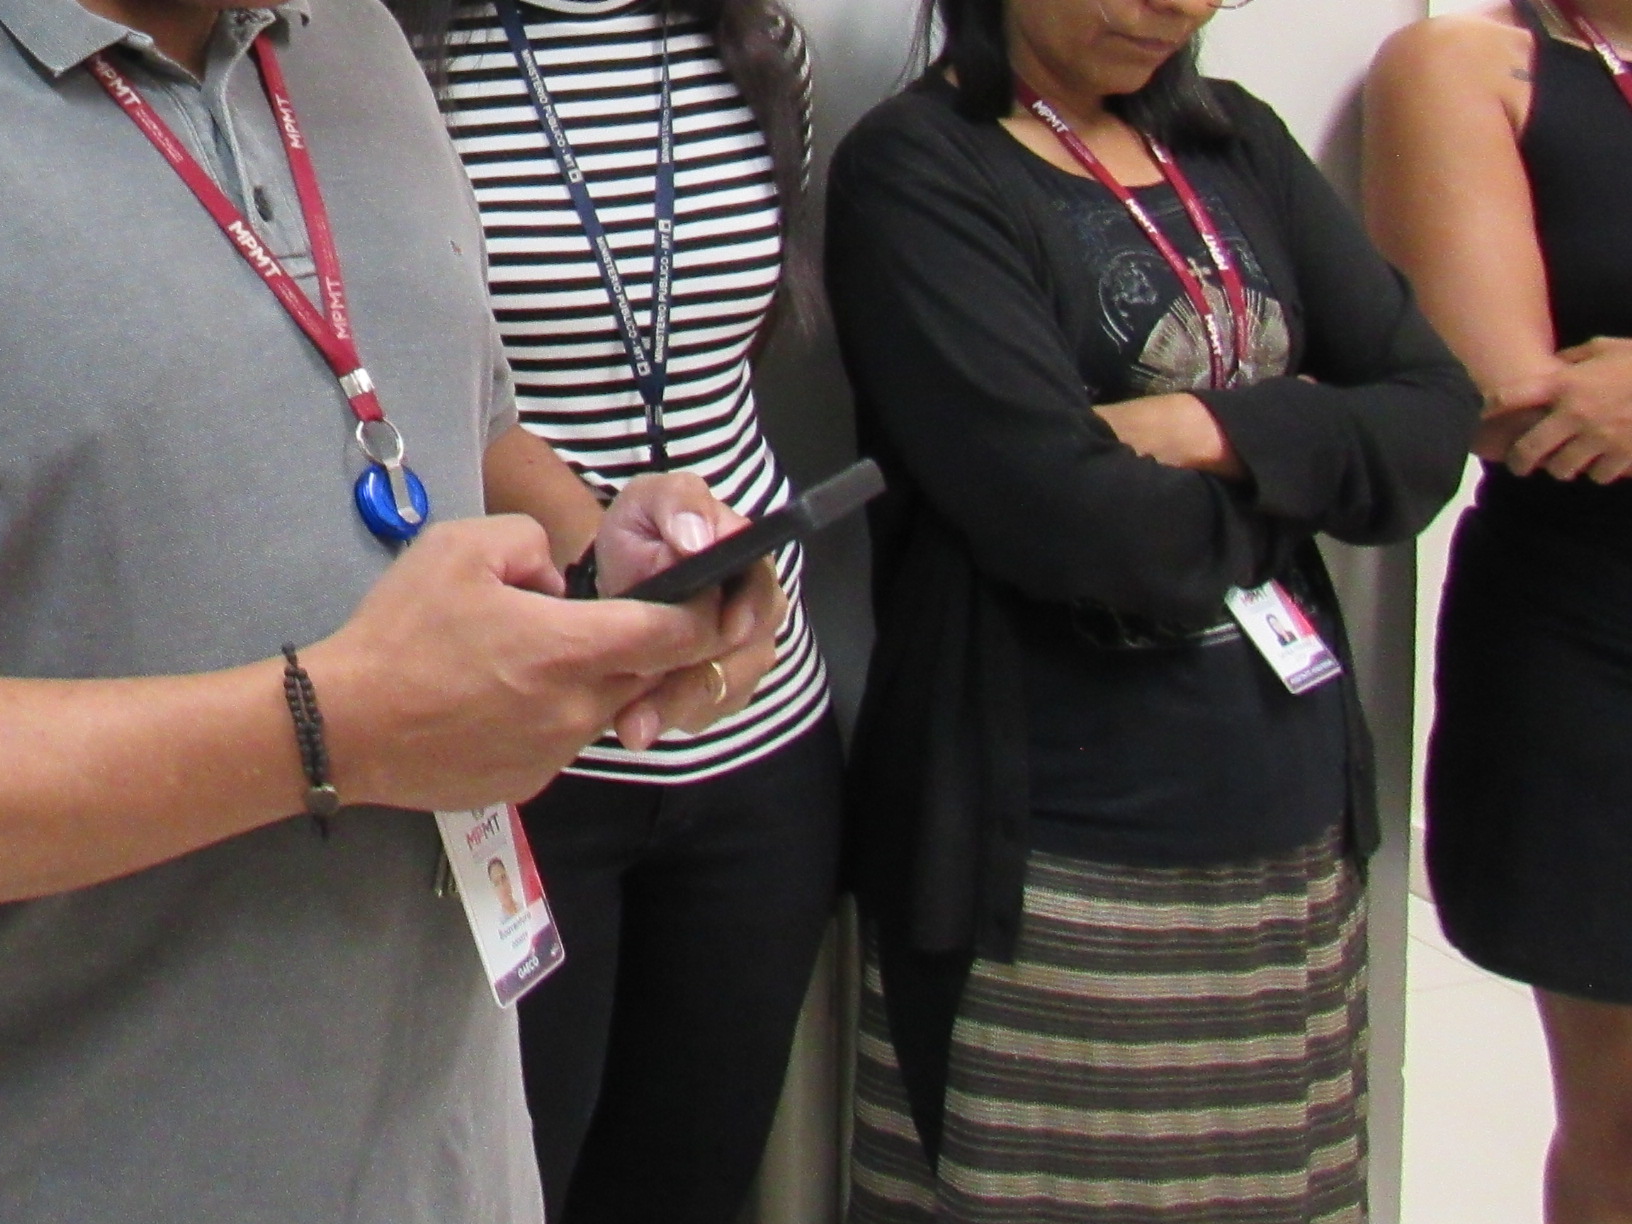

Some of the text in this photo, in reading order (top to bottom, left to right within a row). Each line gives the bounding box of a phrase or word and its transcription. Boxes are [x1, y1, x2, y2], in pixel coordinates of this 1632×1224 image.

[275, 95, 306, 150] MPMT
[1031, 99, 1069, 133] MPMT
[228, 221, 281, 277] MPMT
[325, 276, 351, 340] MPMT
[465, 812, 502, 851] MPMT
